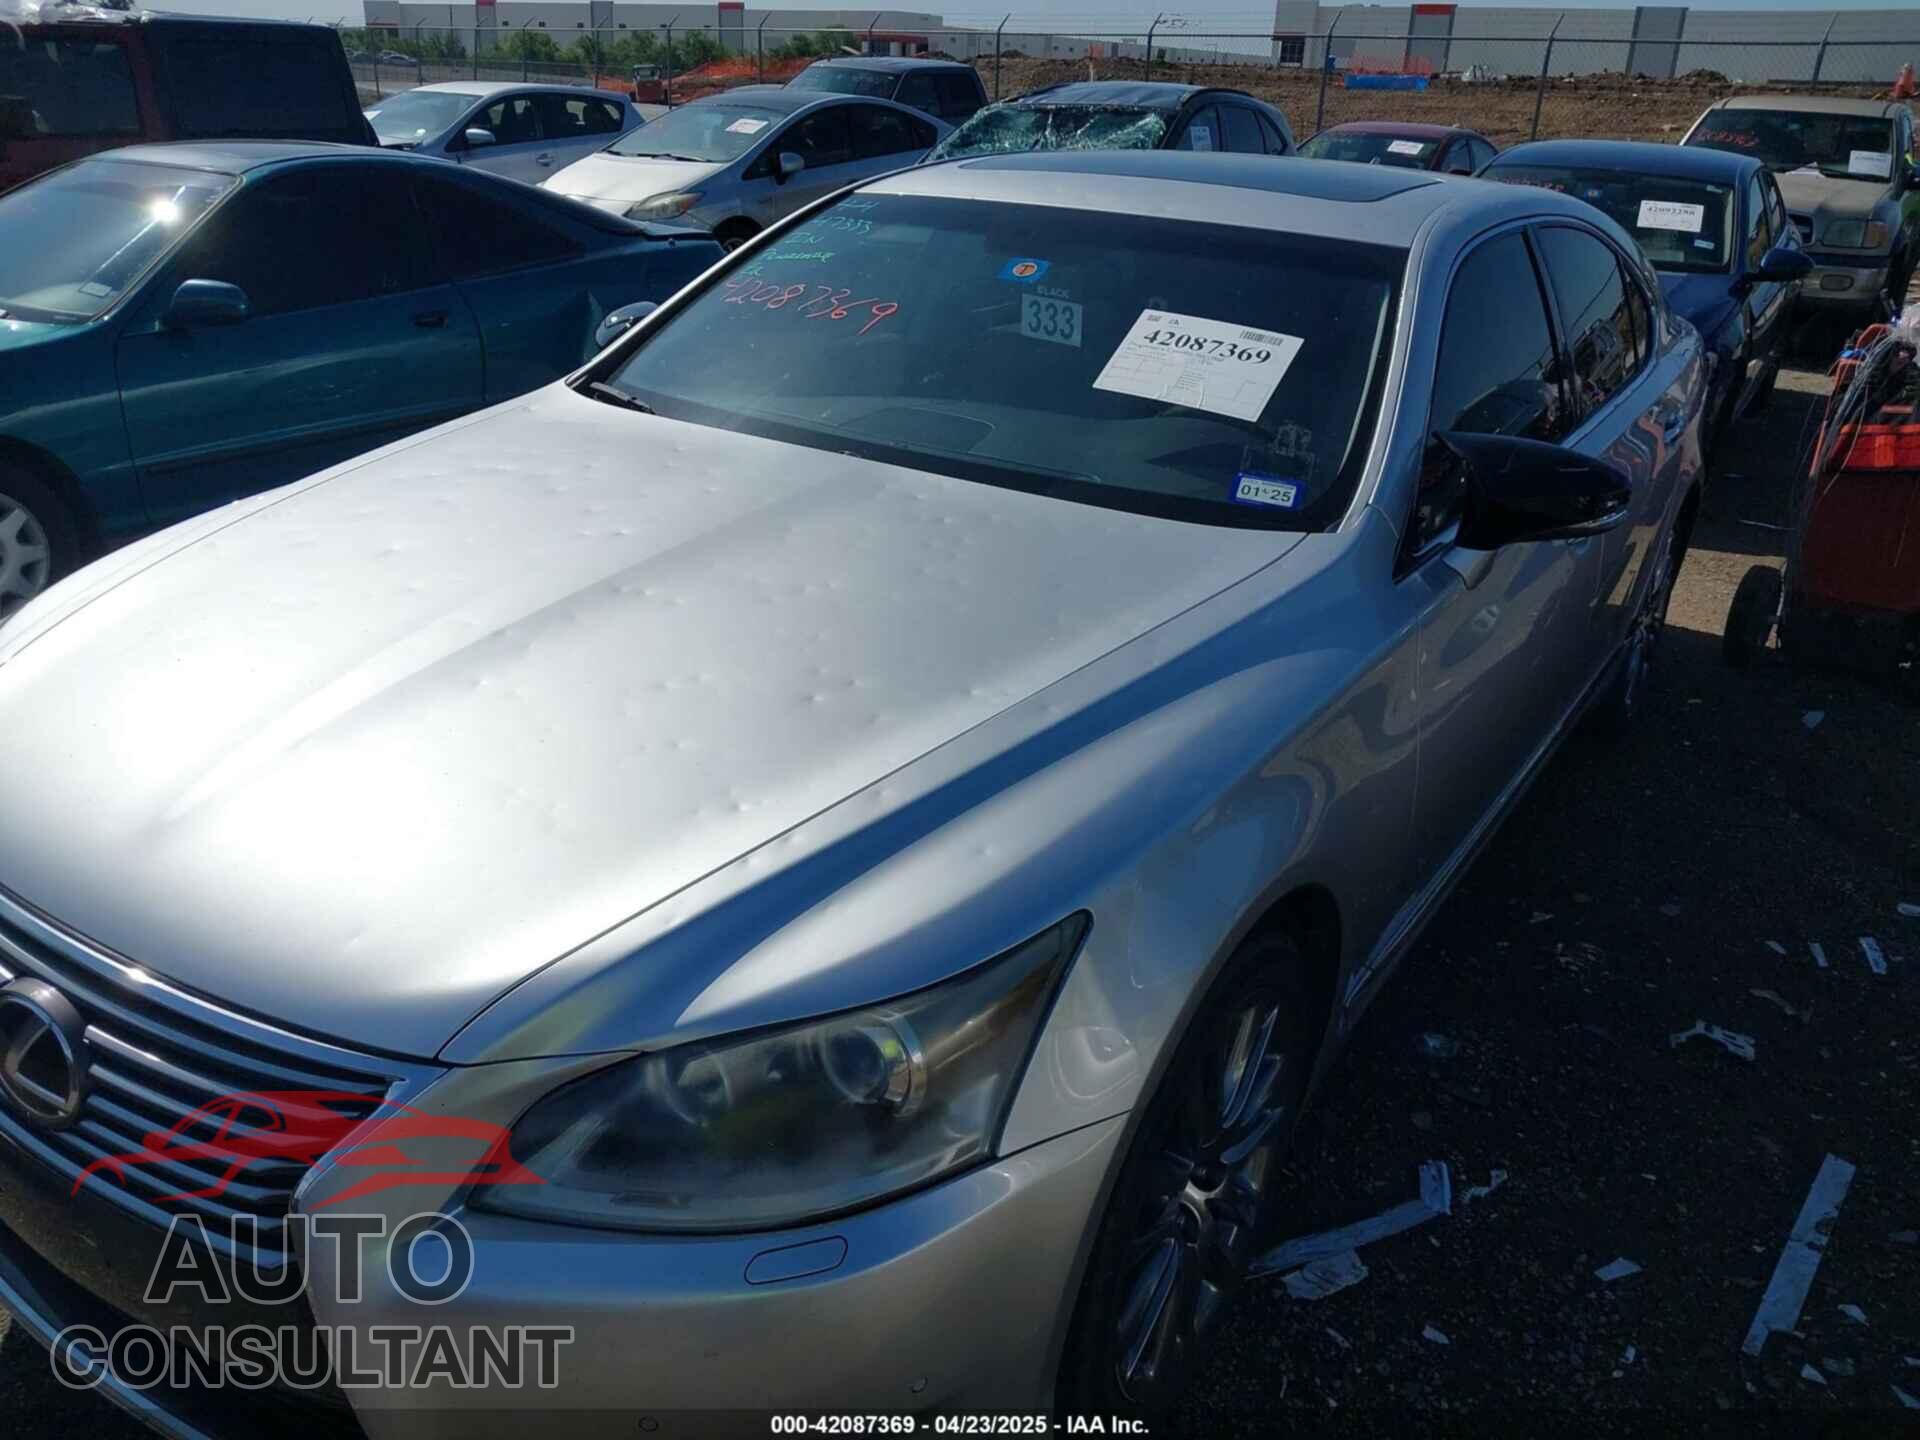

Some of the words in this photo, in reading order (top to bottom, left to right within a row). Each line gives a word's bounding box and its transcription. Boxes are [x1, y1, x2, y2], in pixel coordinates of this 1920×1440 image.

[1028, 300, 1074, 339] 333
[1143, 329, 1272, 365] 42087369
[1240, 484, 1260, 497] 01
[1270, 489, 1292, 502] 25
